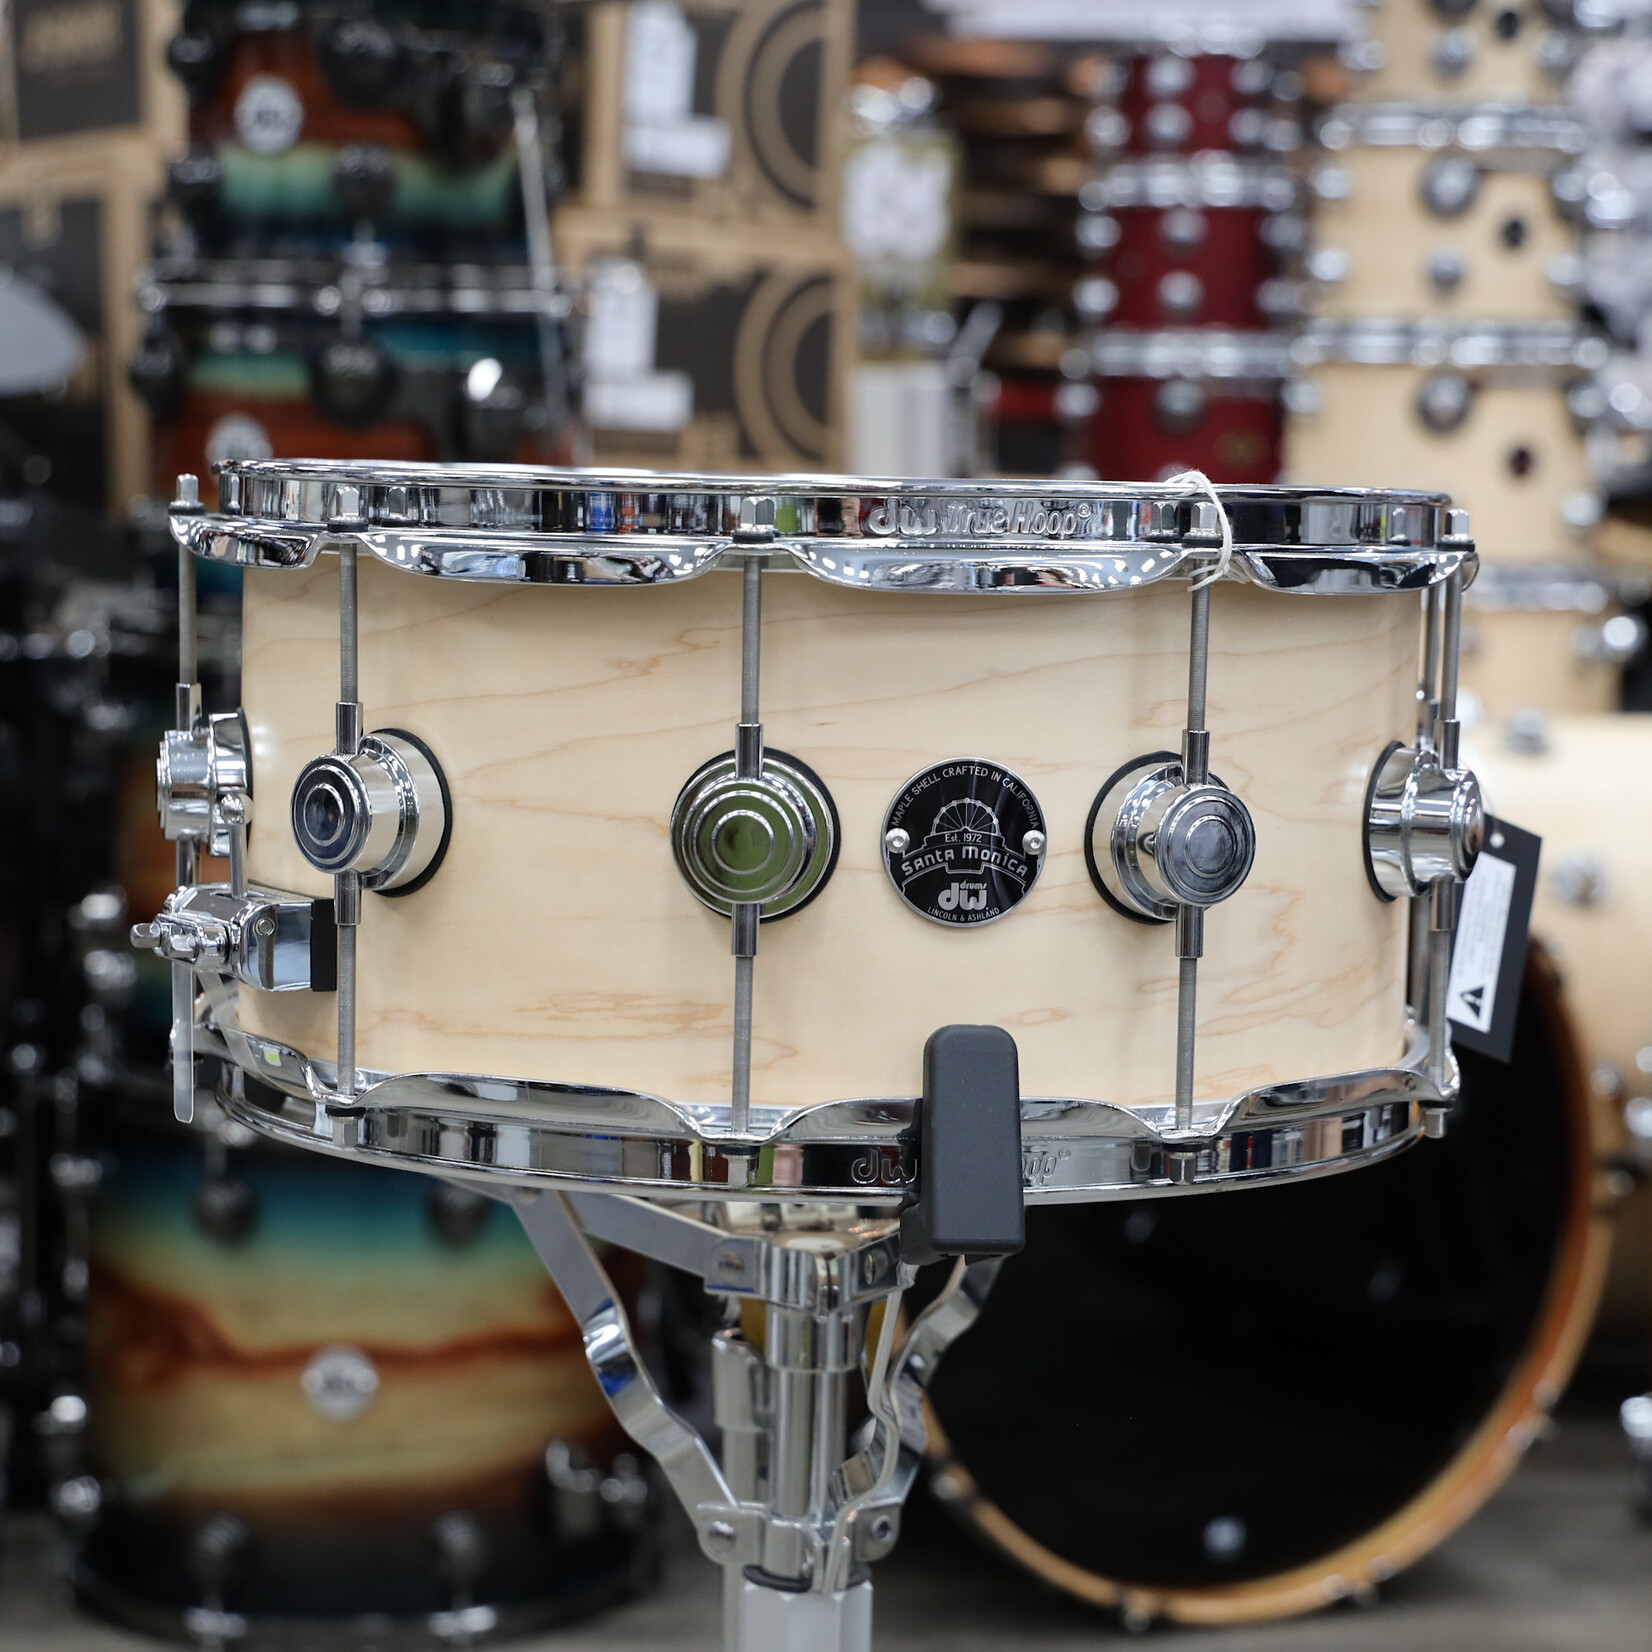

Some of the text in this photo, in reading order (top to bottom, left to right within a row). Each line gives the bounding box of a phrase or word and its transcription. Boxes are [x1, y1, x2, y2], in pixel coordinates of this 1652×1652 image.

[867, 498, 938, 535] dw
[891, 765, 1040, 829] MAPLE SHELL CRAFTED IN CALIFORNIA
[944, 833, 982, 843] Est. 1972
[960, 880, 987, 890] drums
[938, 882, 987, 911] dw
[928, 906, 957, 921] LINCOLN
[968, 907, 1000, 921] ASHLAND
